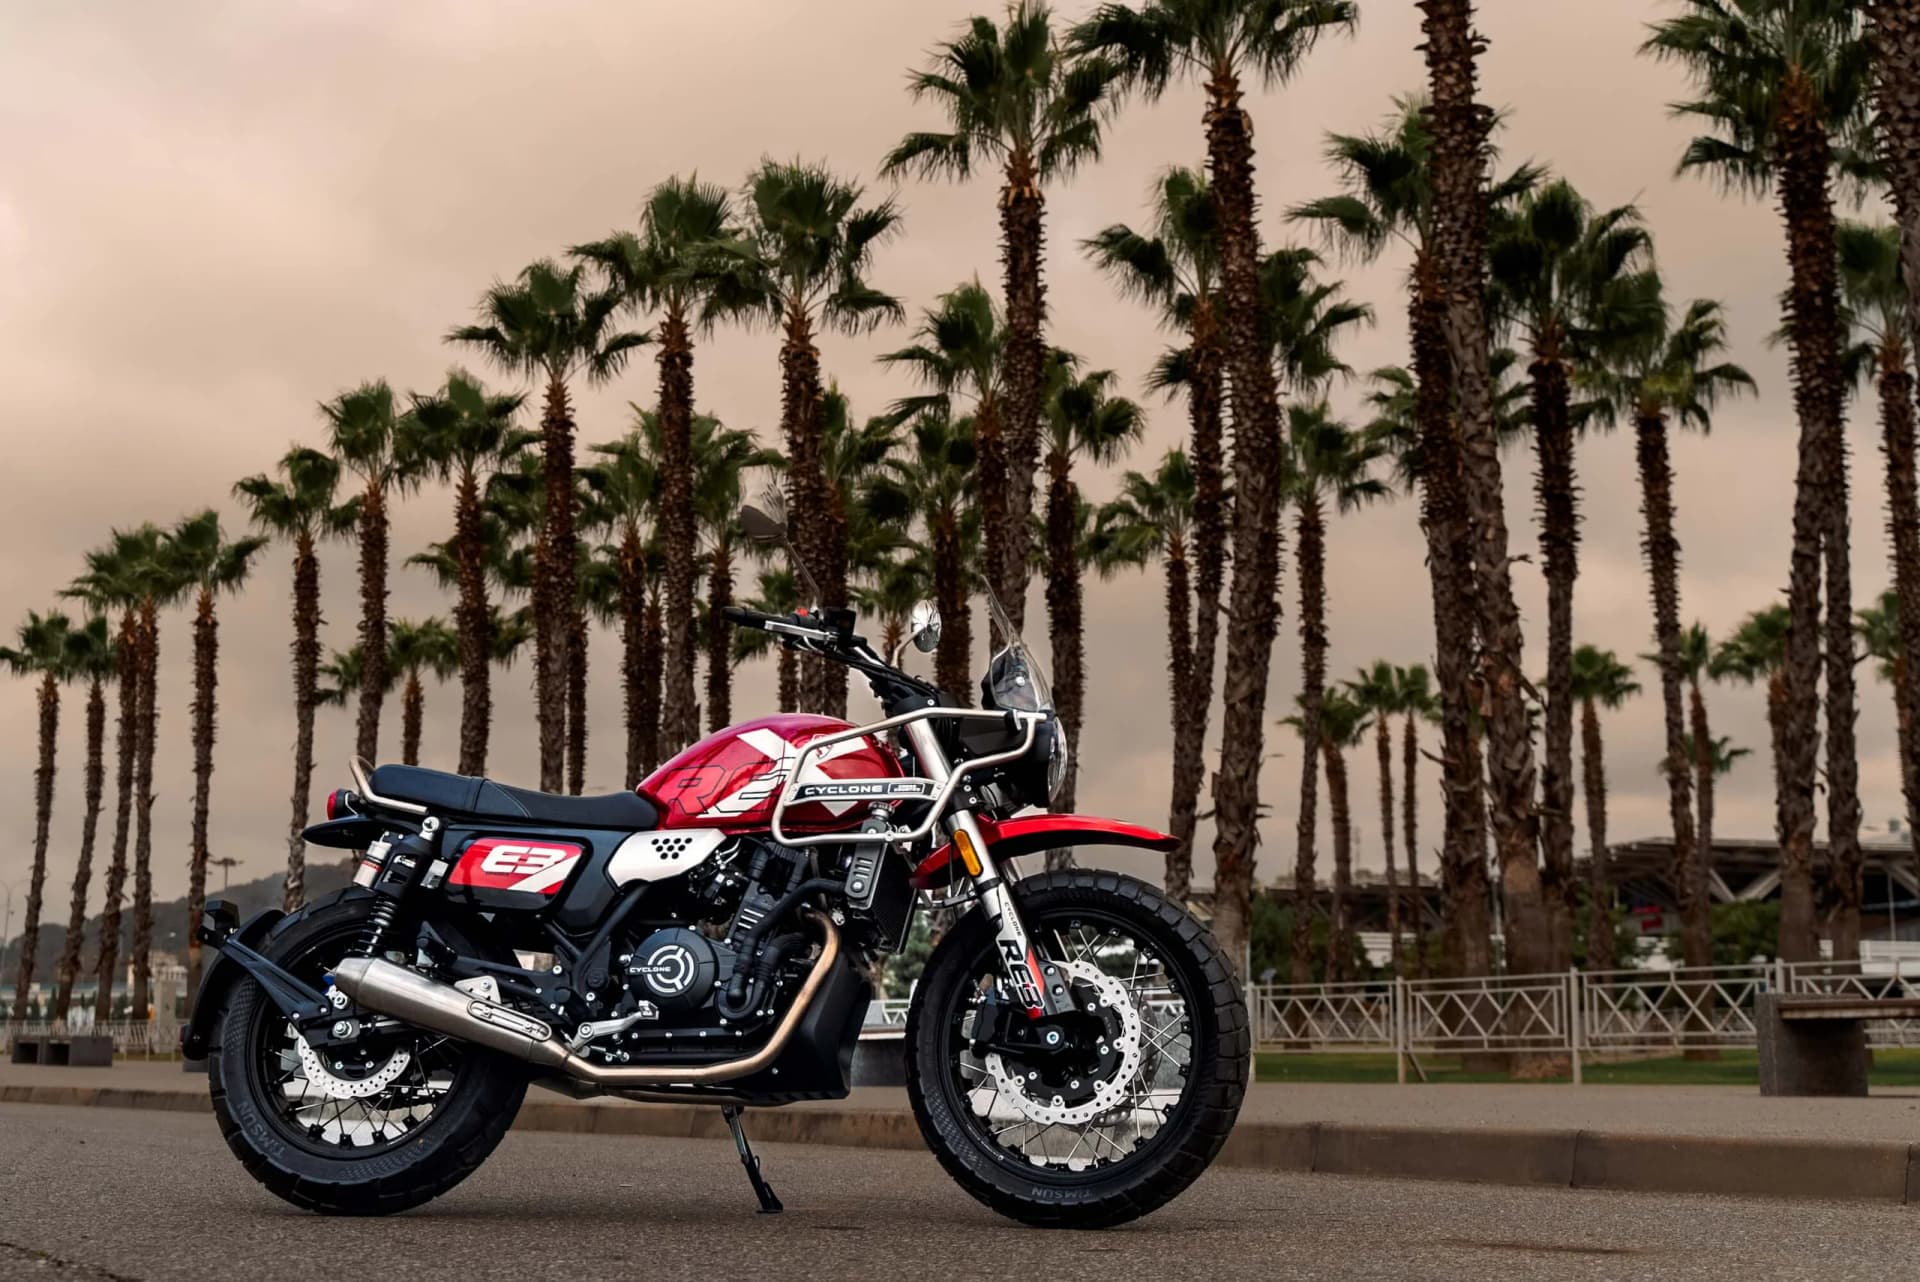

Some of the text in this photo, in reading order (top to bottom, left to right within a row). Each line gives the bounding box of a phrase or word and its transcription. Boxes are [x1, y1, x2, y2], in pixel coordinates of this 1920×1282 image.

[804, 784, 883, 796] CYCLONE
[1004, 902, 1022, 936] CYCLONE
[998, 940, 1044, 1008] RE3
